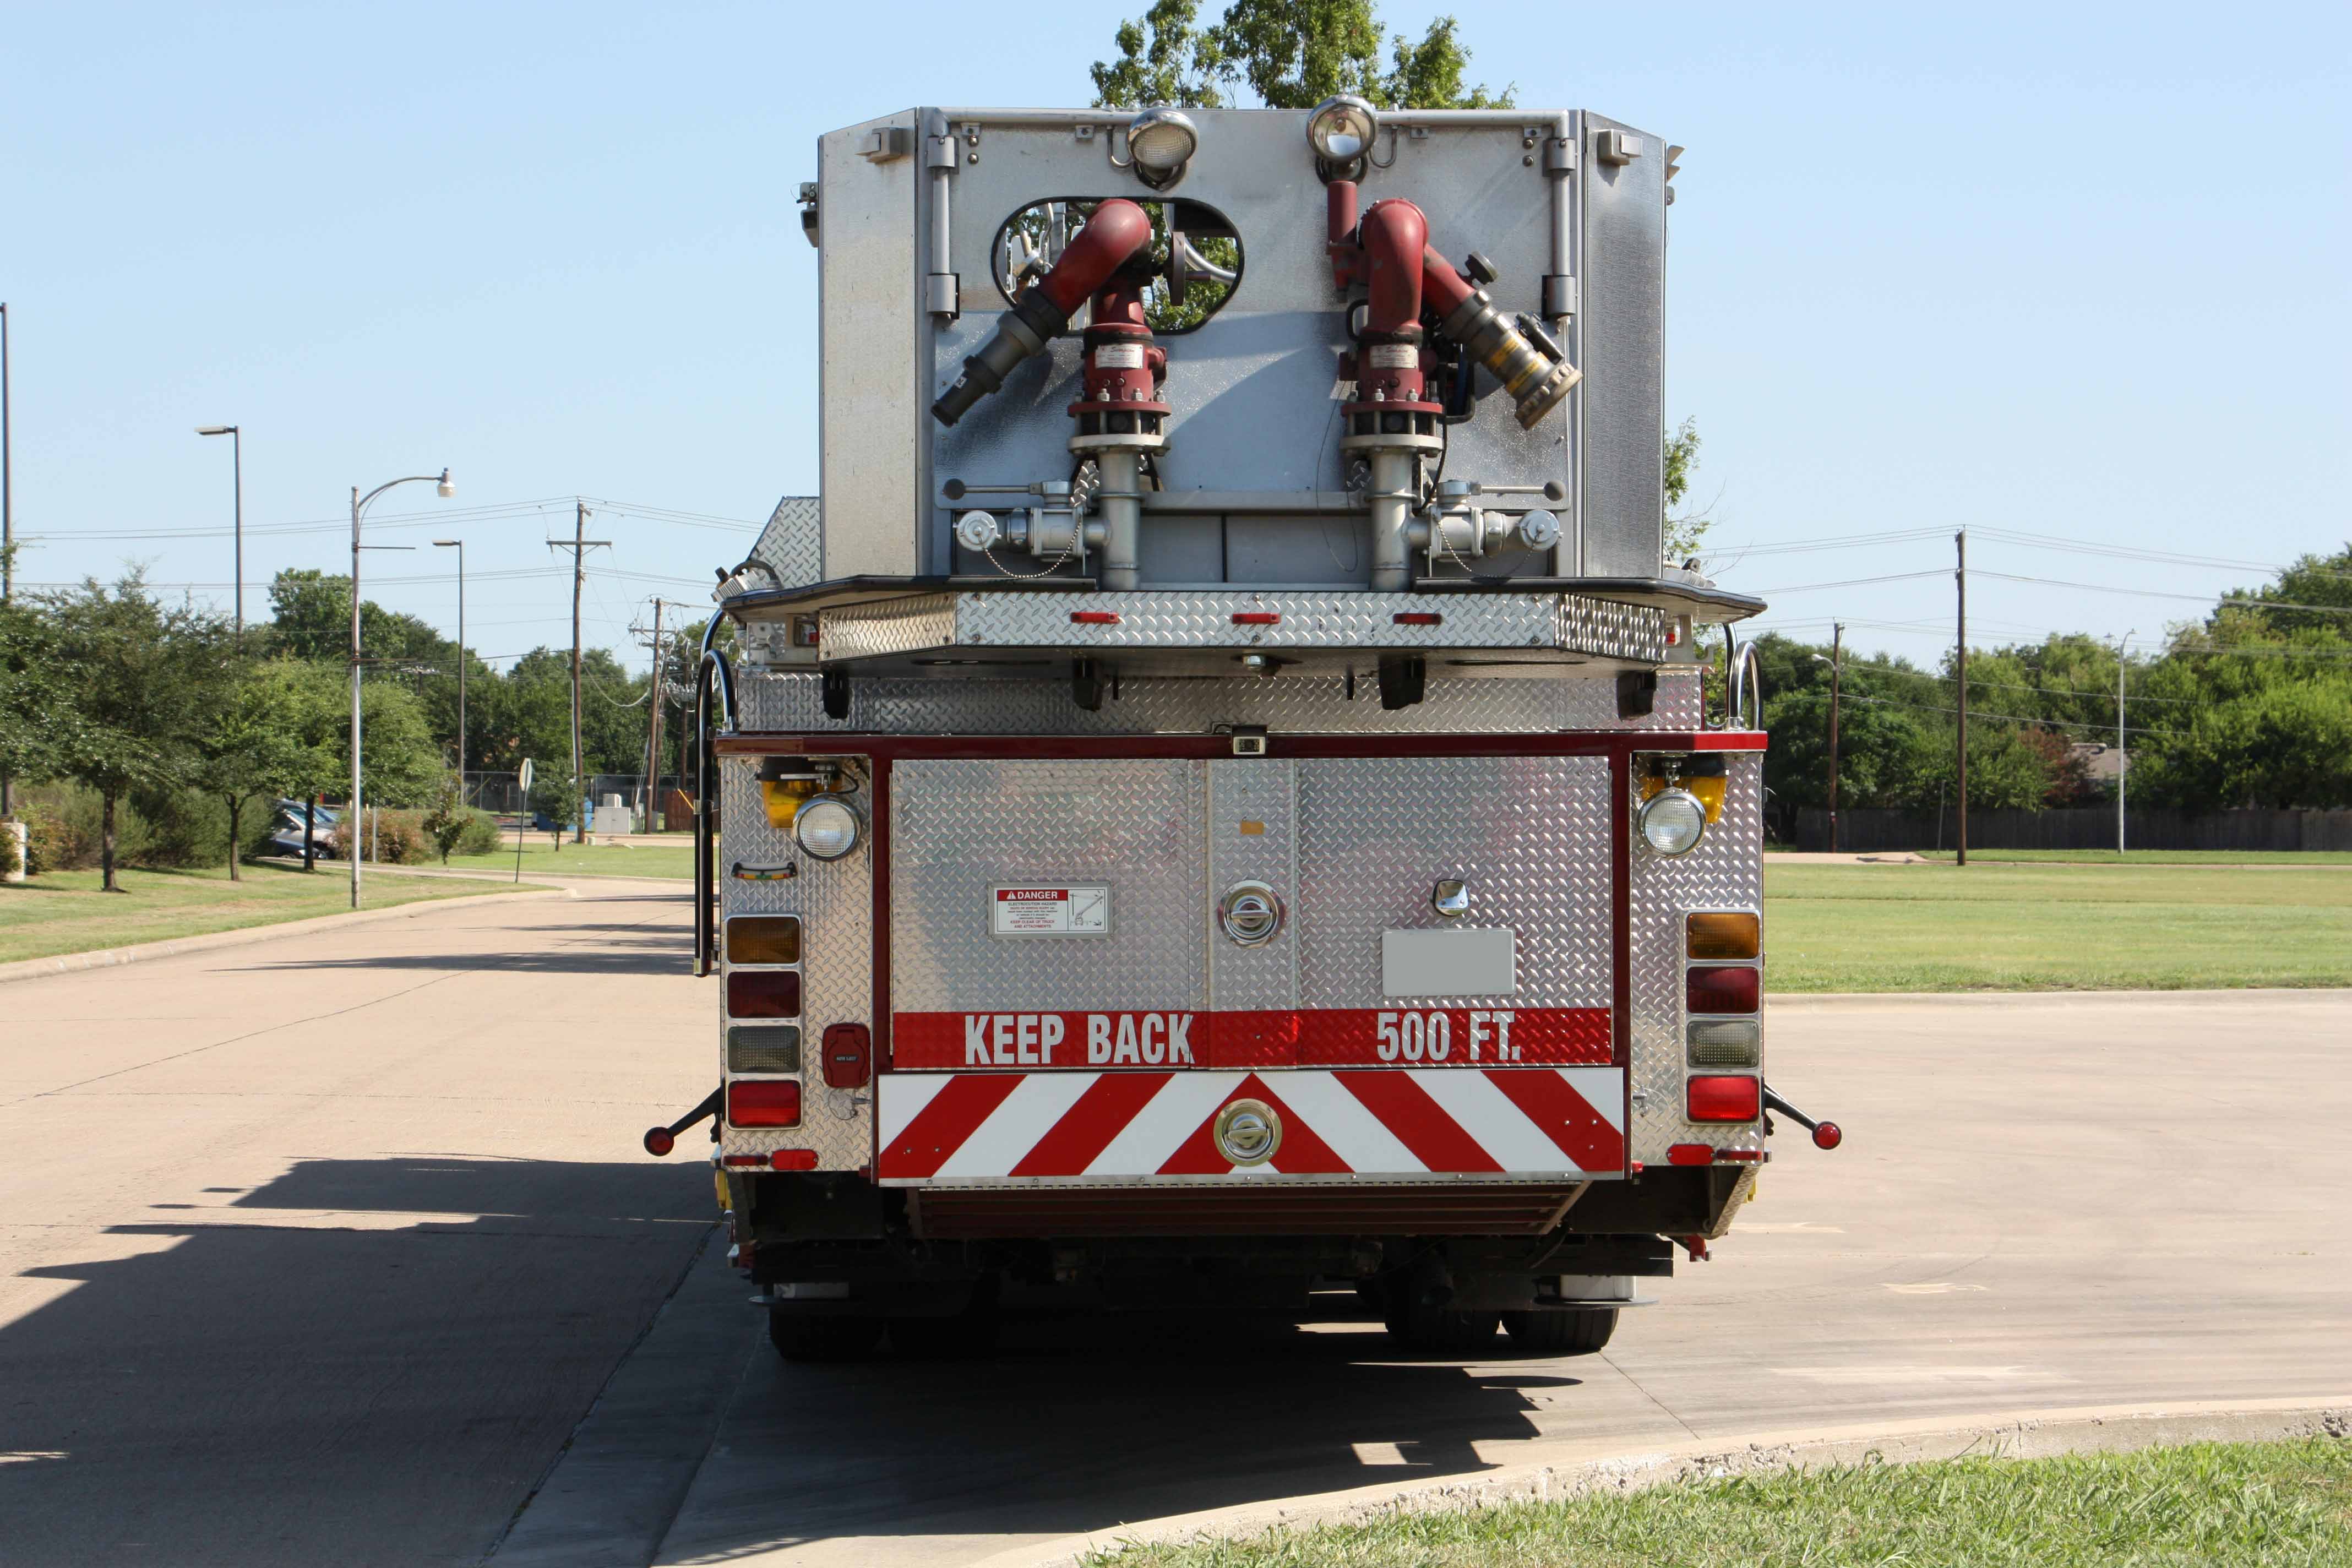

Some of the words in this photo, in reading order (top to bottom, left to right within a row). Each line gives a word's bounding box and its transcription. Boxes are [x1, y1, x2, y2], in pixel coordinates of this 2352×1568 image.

[965, 1015, 1064, 1064] KEEP
[1088, 1013, 1195, 1064] BACK
[1378, 1011, 1450, 1061] 500
[1469, 1011, 1521, 1060] FT.
